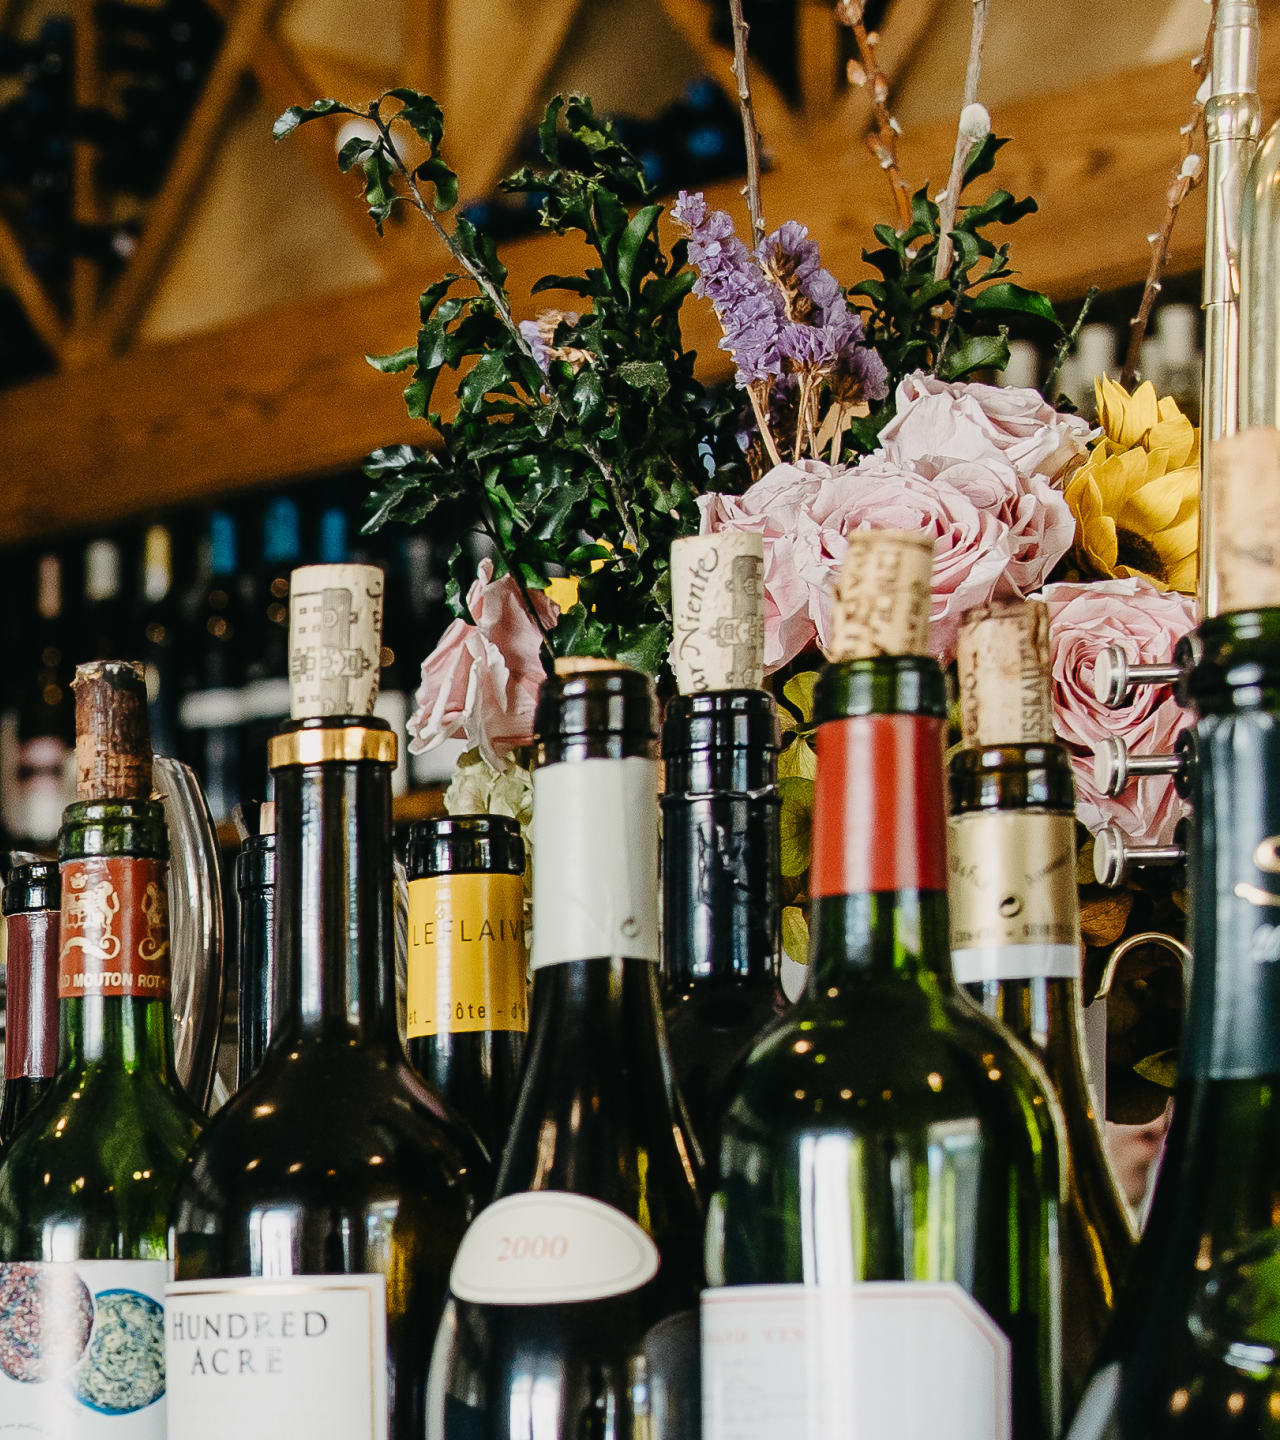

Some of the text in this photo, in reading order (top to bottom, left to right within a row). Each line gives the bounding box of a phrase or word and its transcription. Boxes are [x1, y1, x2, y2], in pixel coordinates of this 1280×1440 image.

[679, 547, 719, 693] ar Niente
[413, 919, 521, 947] LEFLAIV
[72, 972, 162, 988] MOUTON ROT
[495, 1234, 570, 1263] 2000
[171, 1309, 328, 1341] HUNDRED
[190, 1346, 283, 1375] ACRE
